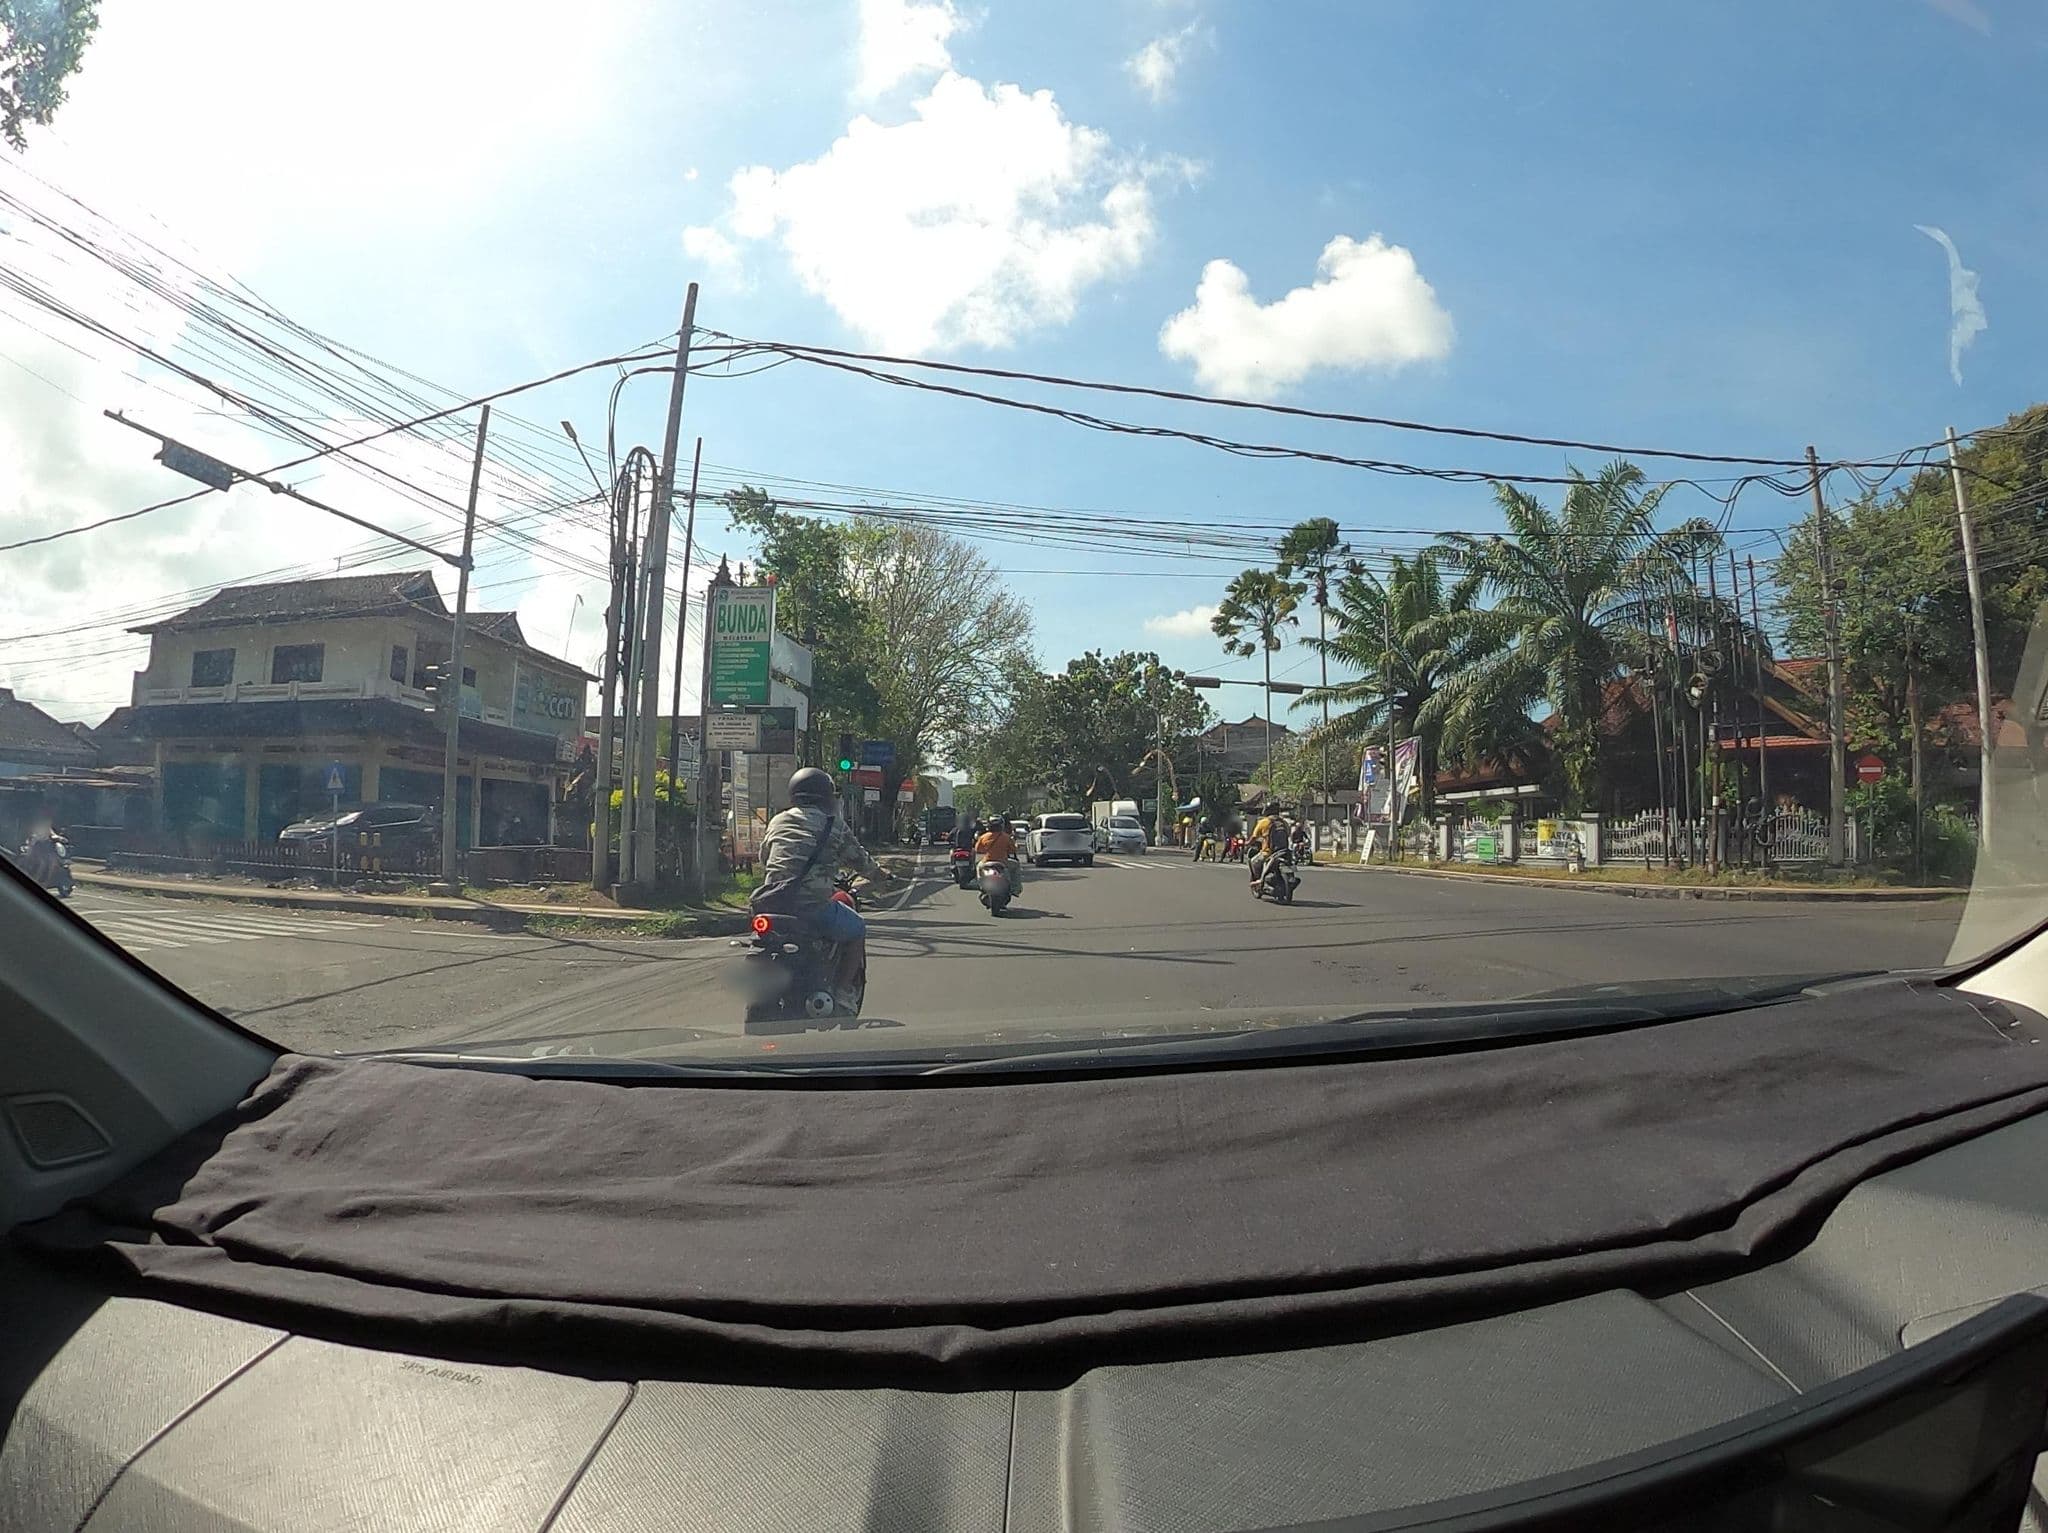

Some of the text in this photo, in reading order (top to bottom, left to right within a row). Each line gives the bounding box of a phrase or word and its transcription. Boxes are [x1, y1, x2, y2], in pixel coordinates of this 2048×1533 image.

[717, 603, 767, 633] BUNDA
[549, 697, 577, 719] CCTV
[426, 1368, 483, 1385] AIRBAG
